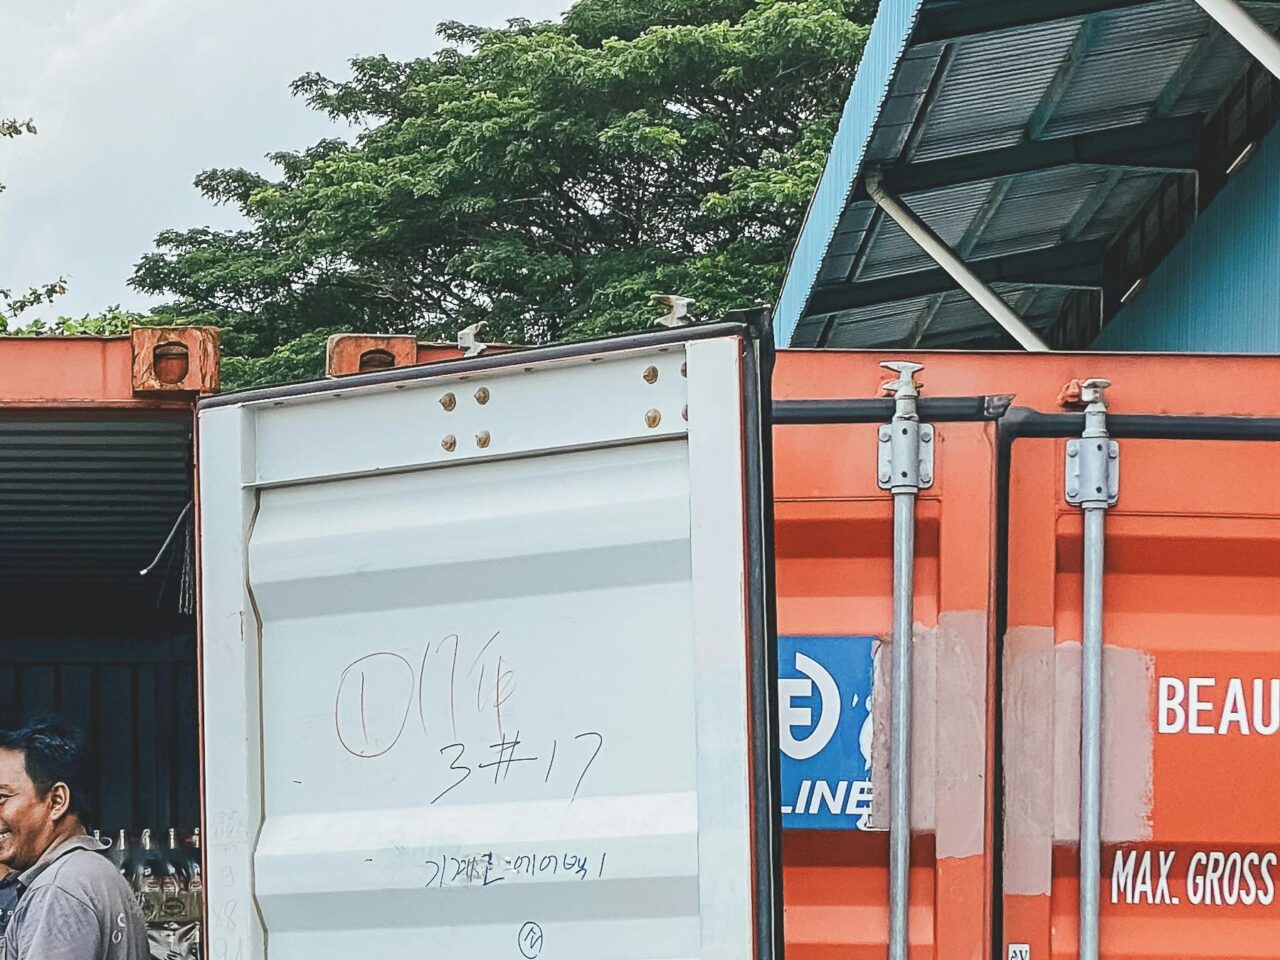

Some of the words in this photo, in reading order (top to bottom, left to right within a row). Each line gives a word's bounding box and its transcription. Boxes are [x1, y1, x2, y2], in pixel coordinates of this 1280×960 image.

[1157, 676, 1280, 735] BEAU
[1110, 851, 1180, 906] MAX.
[1187, 851, 1279, 906] GROSS
